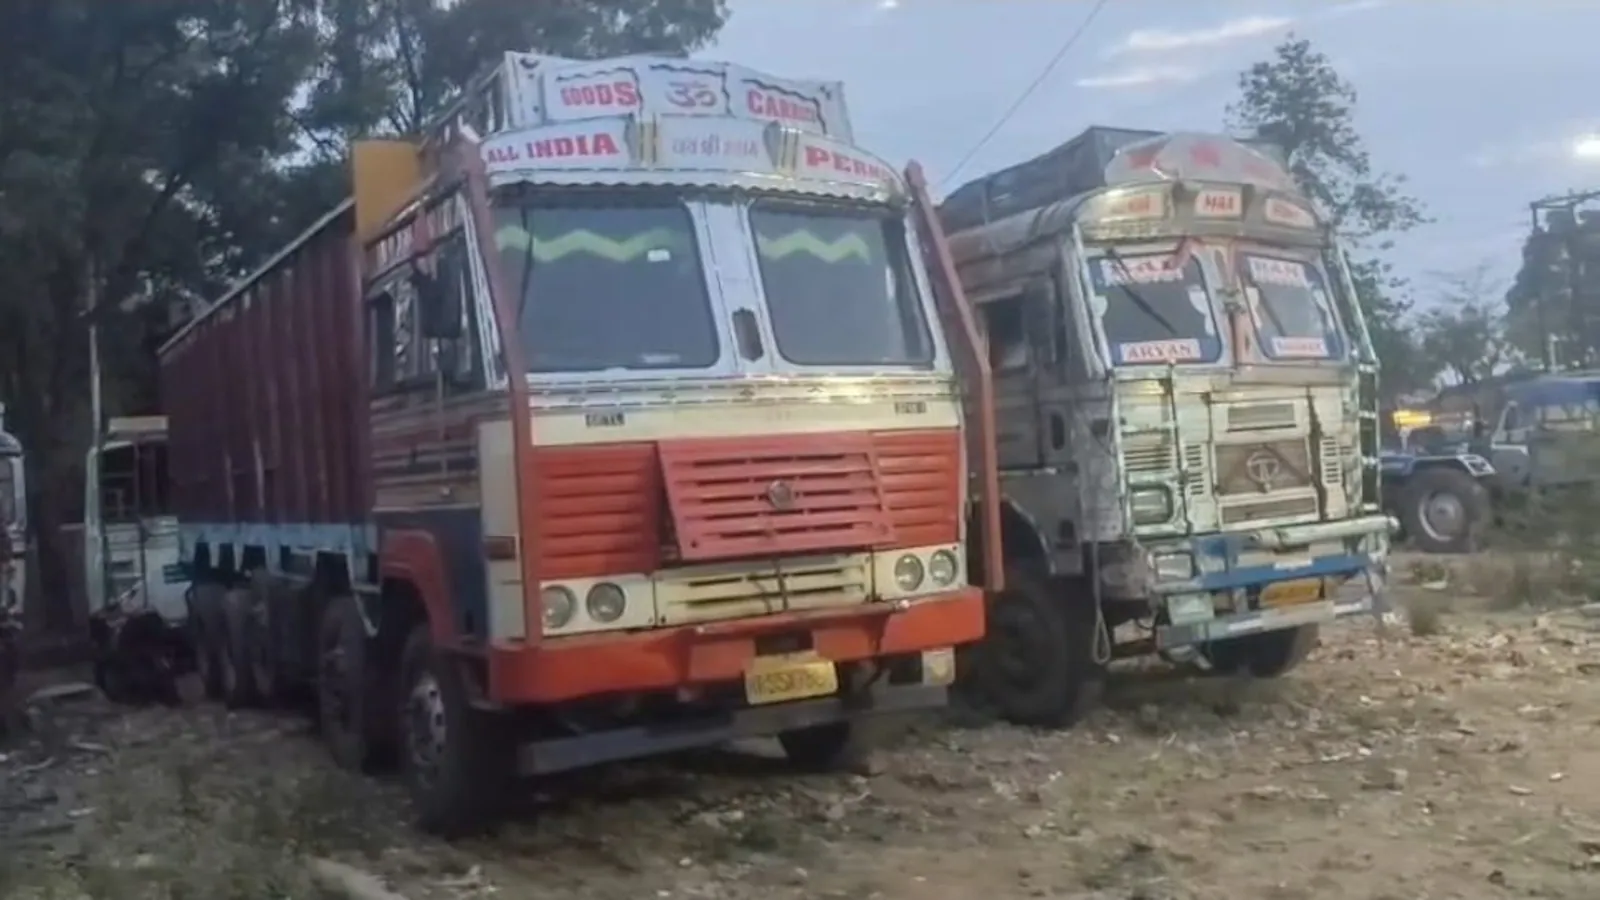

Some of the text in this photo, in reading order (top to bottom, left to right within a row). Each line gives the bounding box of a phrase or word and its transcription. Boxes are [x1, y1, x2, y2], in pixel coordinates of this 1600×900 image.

[560, 81, 638, 106] GOODS
[487, 132, 620, 164] ALL INDIA
[1126, 343, 1193, 362] ARYAN
